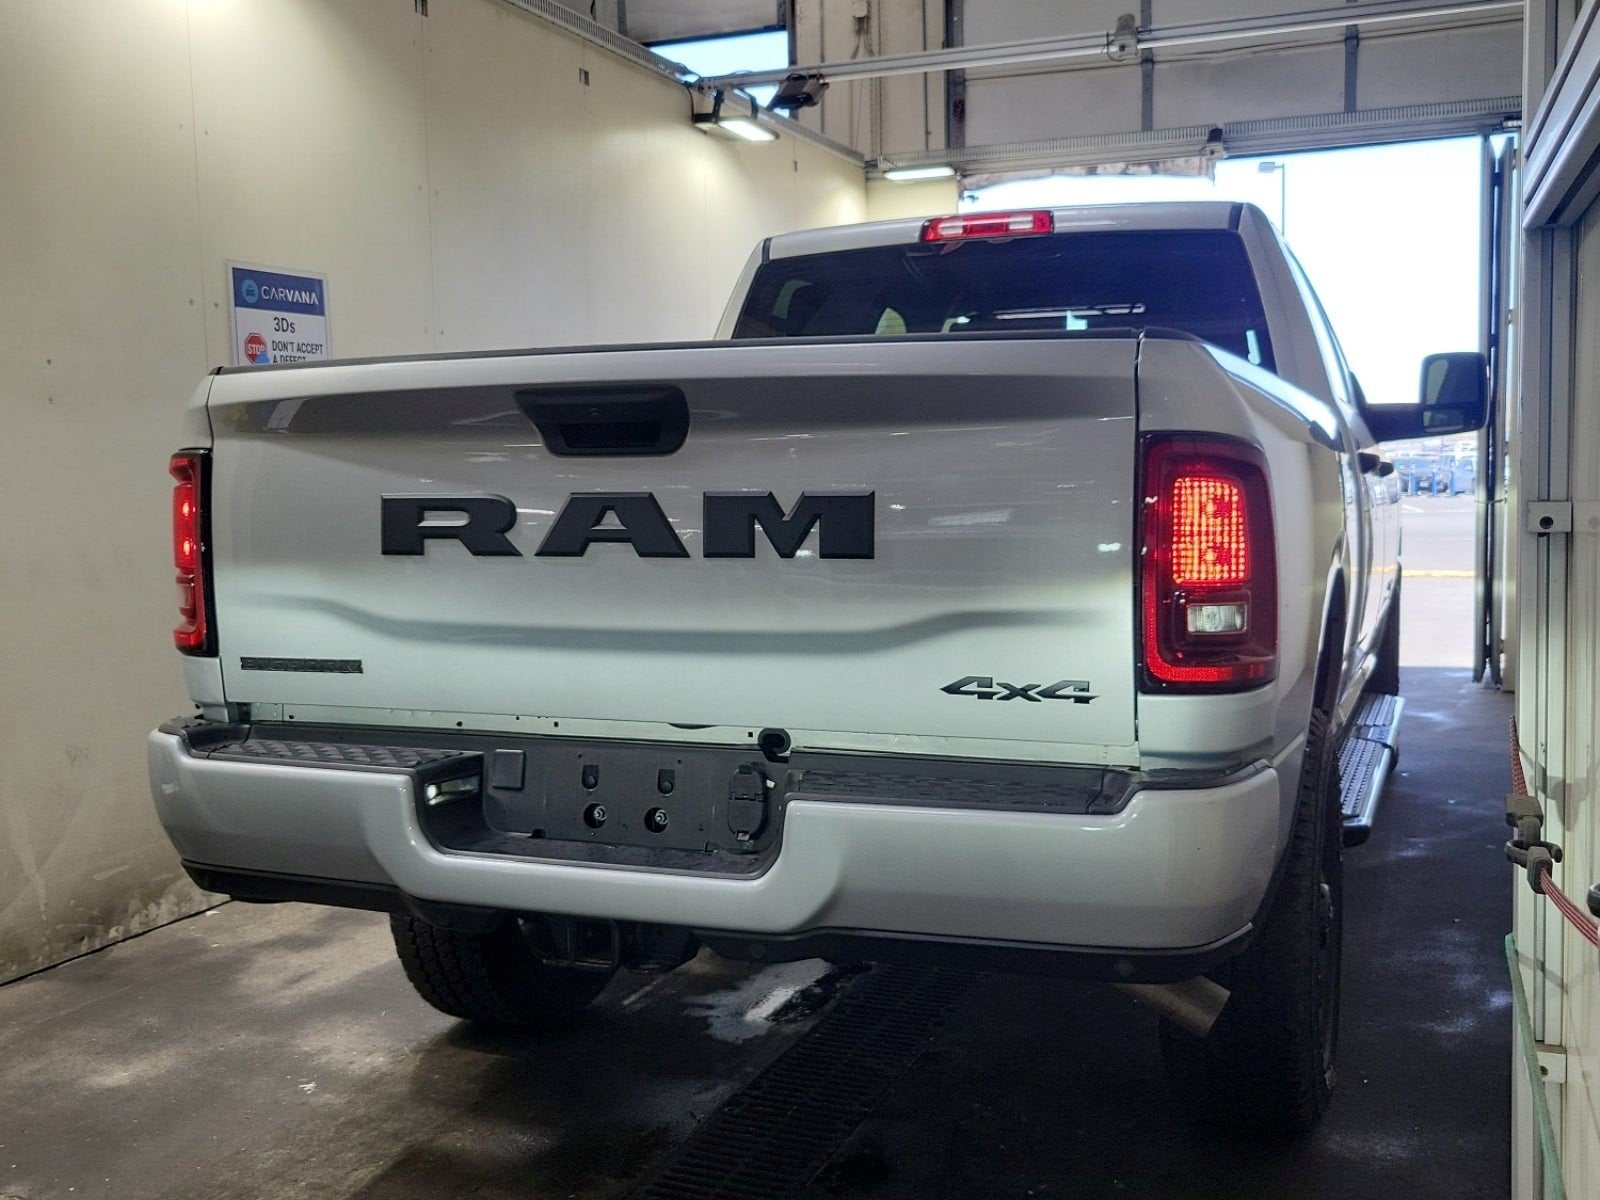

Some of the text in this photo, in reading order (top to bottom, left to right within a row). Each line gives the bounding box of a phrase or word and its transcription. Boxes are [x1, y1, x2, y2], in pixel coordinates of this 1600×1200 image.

[261, 286, 319, 305] CARVANA
[273, 316, 296, 334] 3Ds
[247, 344, 265, 355] STOP
[272, 340, 323, 355] DON'T ACCEPT
[381, 491, 876, 560] RAM
[939, 675, 1101, 704] 4x4
